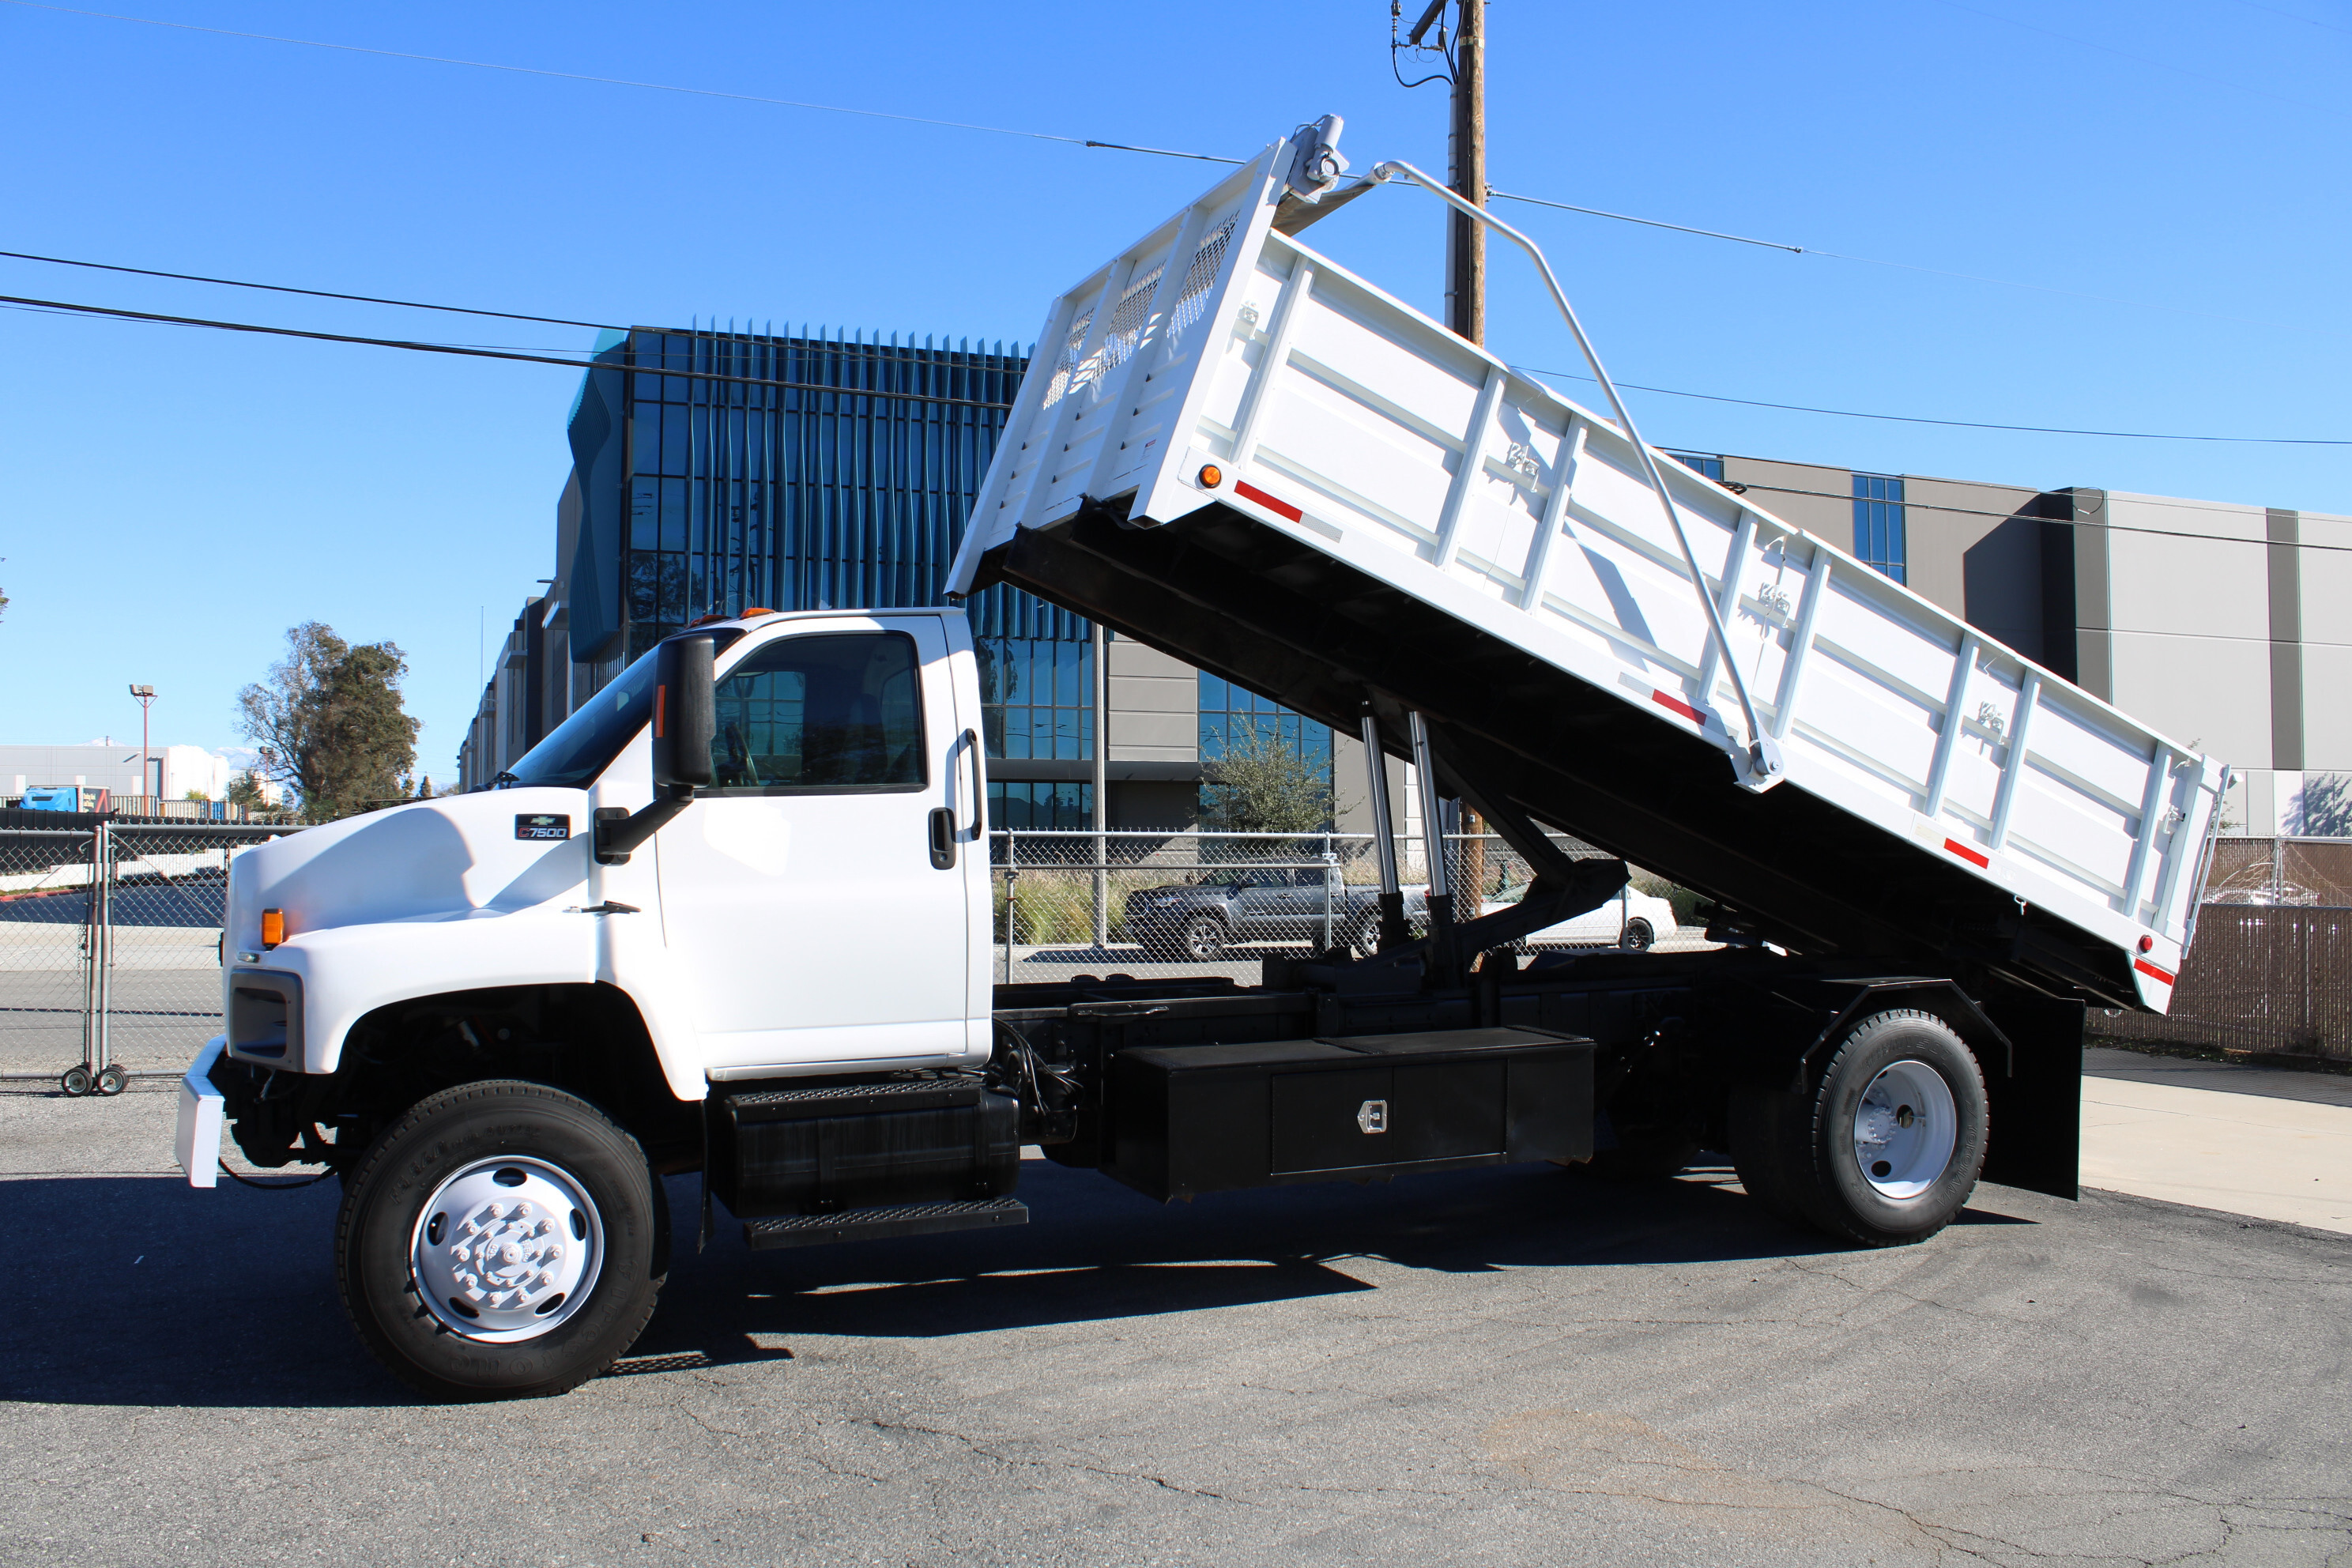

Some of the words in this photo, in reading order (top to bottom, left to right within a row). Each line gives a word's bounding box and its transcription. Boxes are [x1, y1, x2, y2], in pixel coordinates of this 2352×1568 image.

[518, 827, 567, 838] C7500
[1936, 1125, 1978, 1208] YOKOHAMA
[450, 1260, 639, 1378] Firestone
